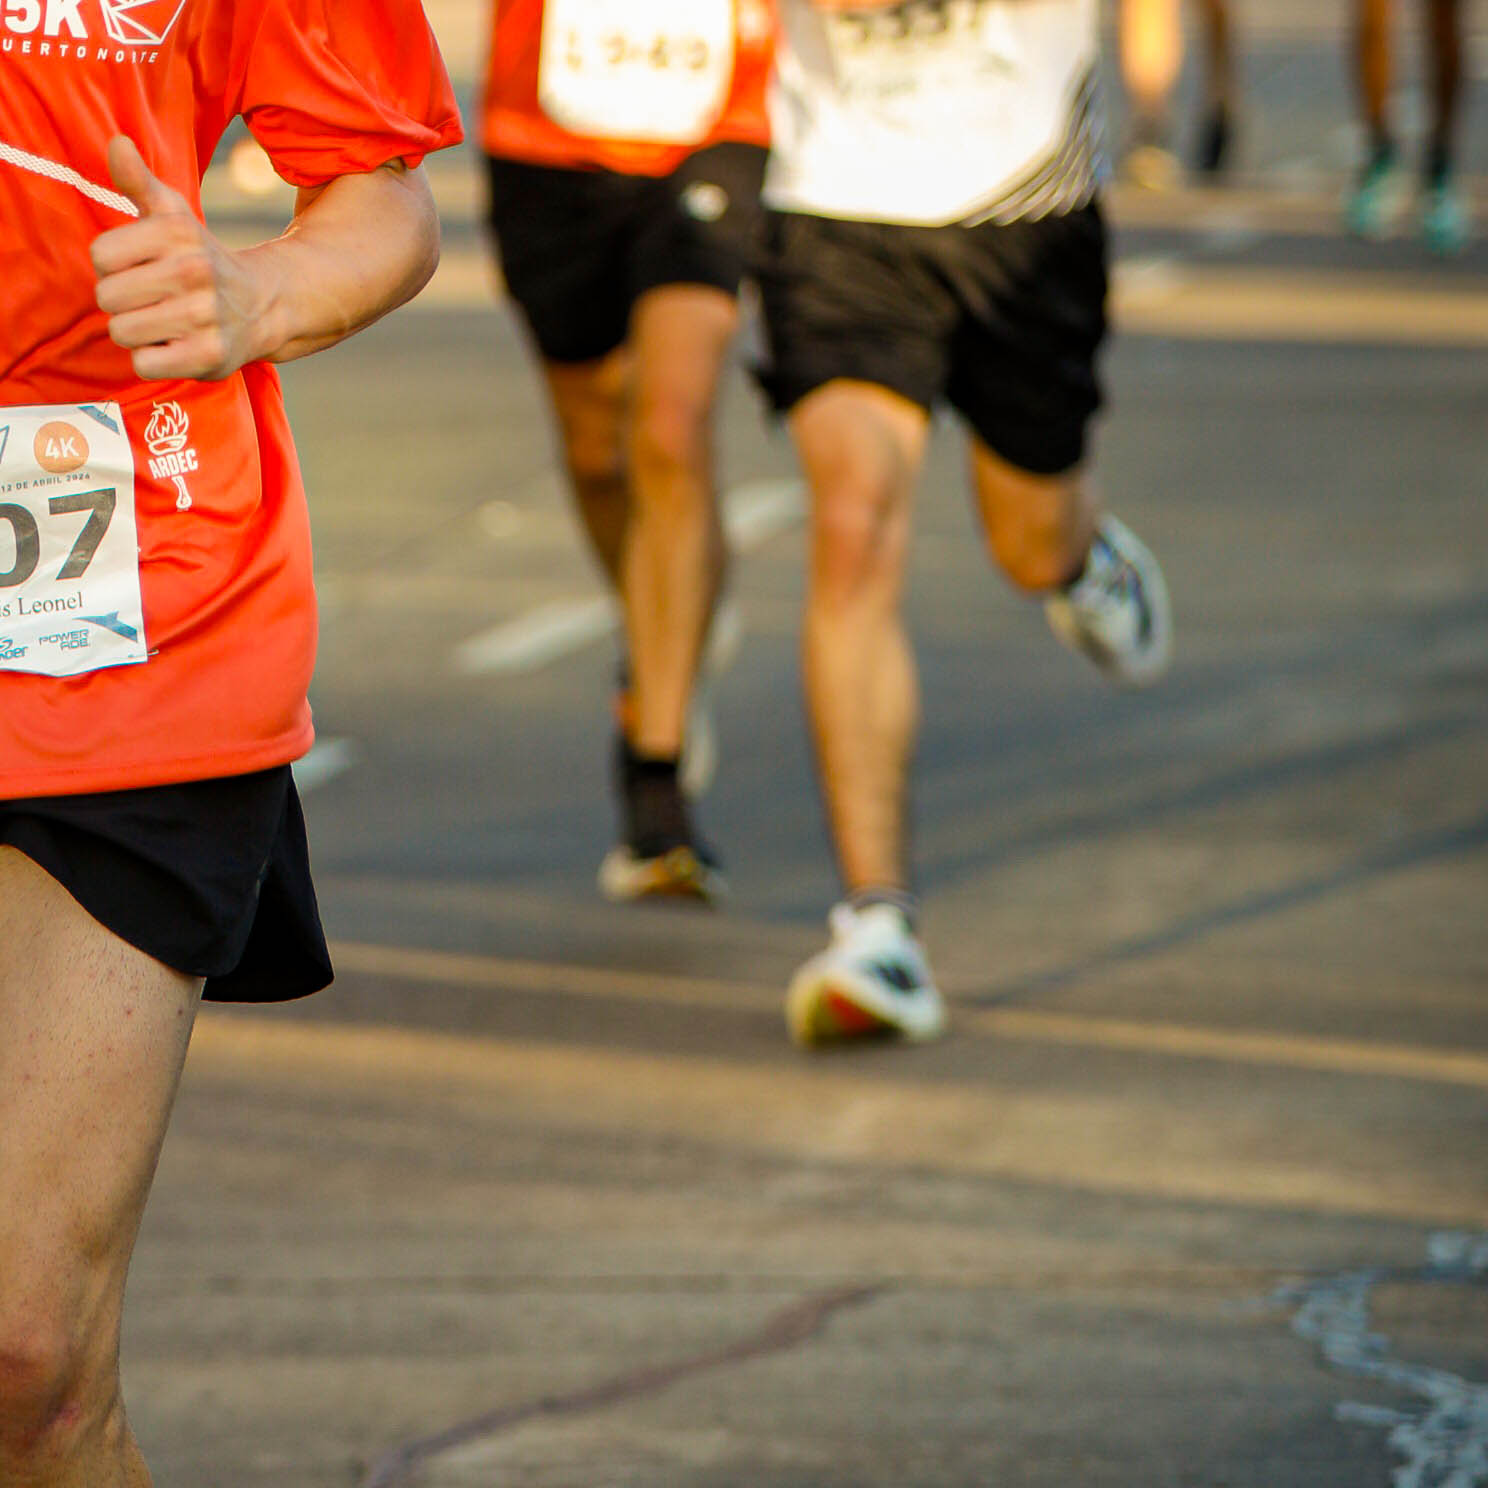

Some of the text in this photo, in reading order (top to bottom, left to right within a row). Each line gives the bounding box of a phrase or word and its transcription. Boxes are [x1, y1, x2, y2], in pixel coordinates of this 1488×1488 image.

[45, 436, 79, 458] 4K
[148, 449, 198, 479] ARDEC
[1, 485, 12, 493] 12
[16, 481, 28, 489] DE
[33, 477, 61, 487] ABRIL
[18, 591, 83, 616] Leonel
[39, 629, 89, 645] POWER
